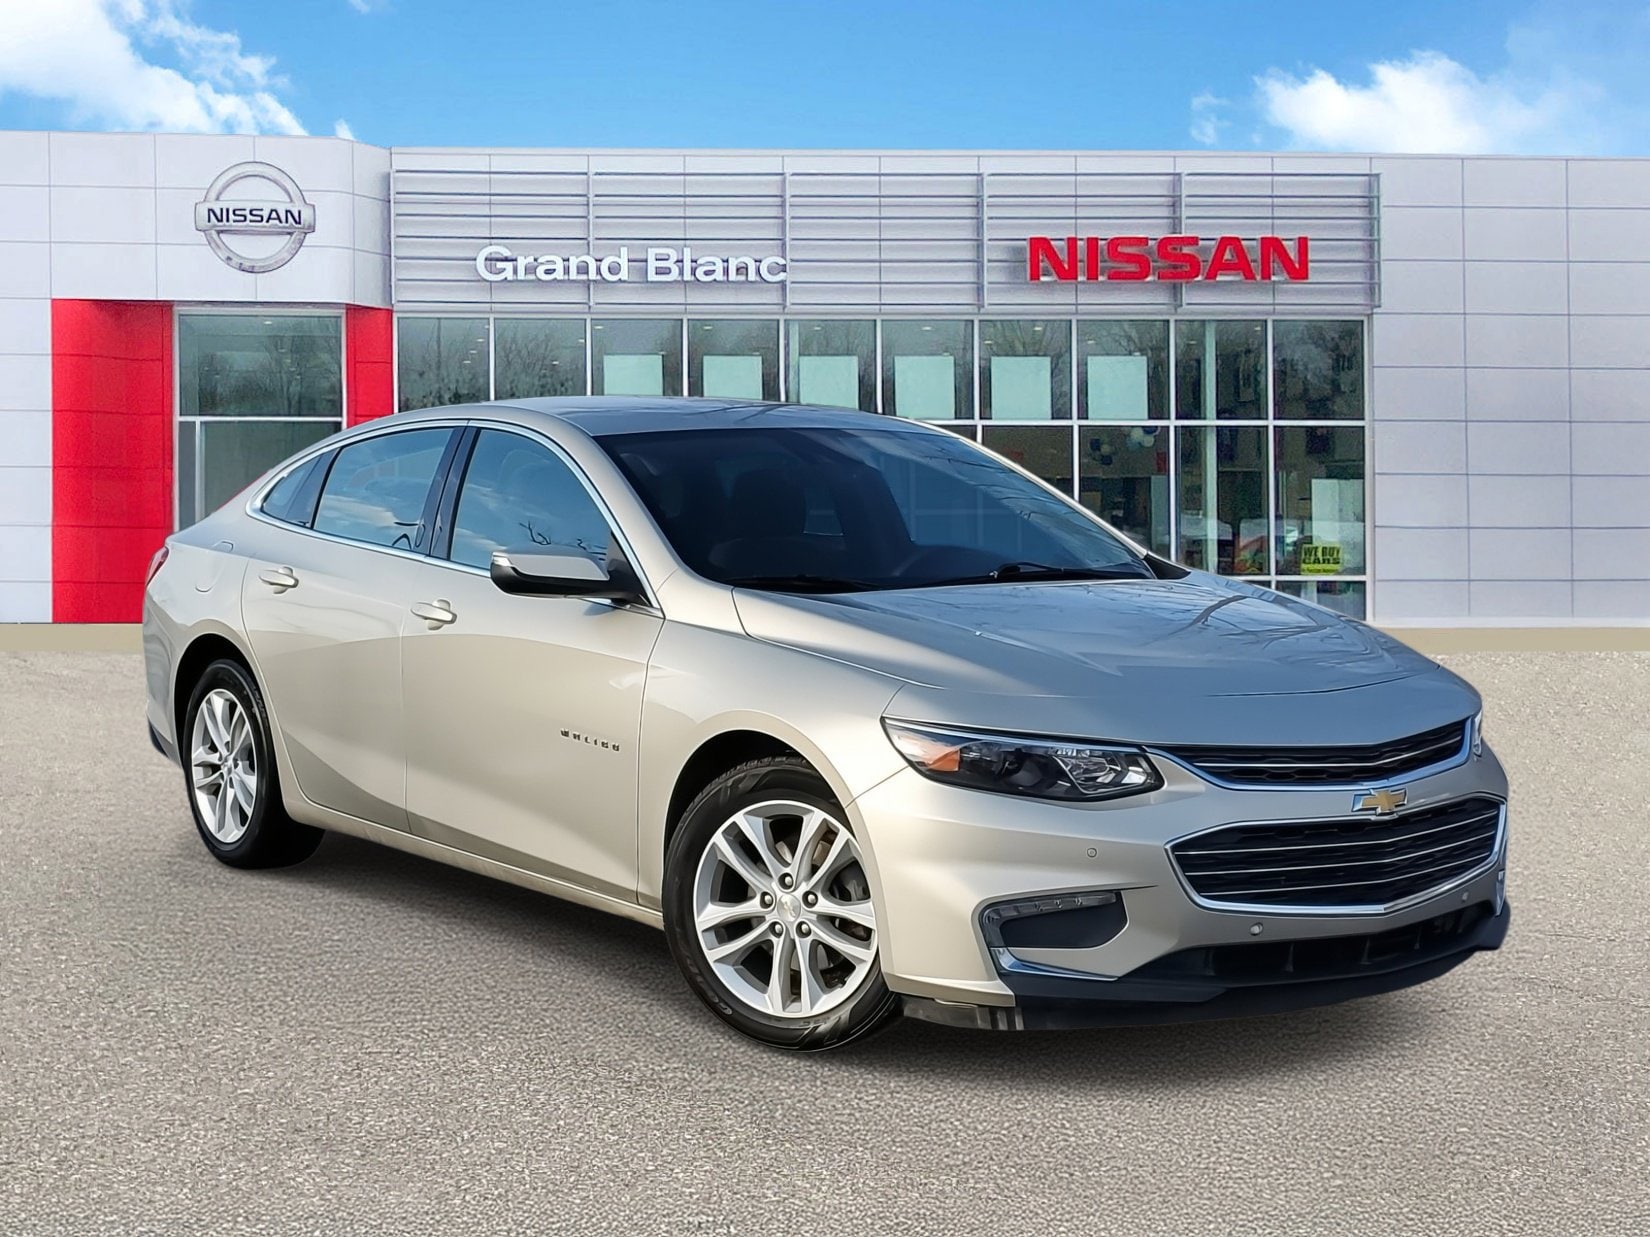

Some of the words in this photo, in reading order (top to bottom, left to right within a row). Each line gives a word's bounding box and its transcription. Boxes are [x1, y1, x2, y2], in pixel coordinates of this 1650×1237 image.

[207, 207, 302, 225] NISSAN
[475, 245, 629, 281] Grand
[646, 247, 787, 282] Blanc
[1028, 236, 1309, 281] NISSAN
